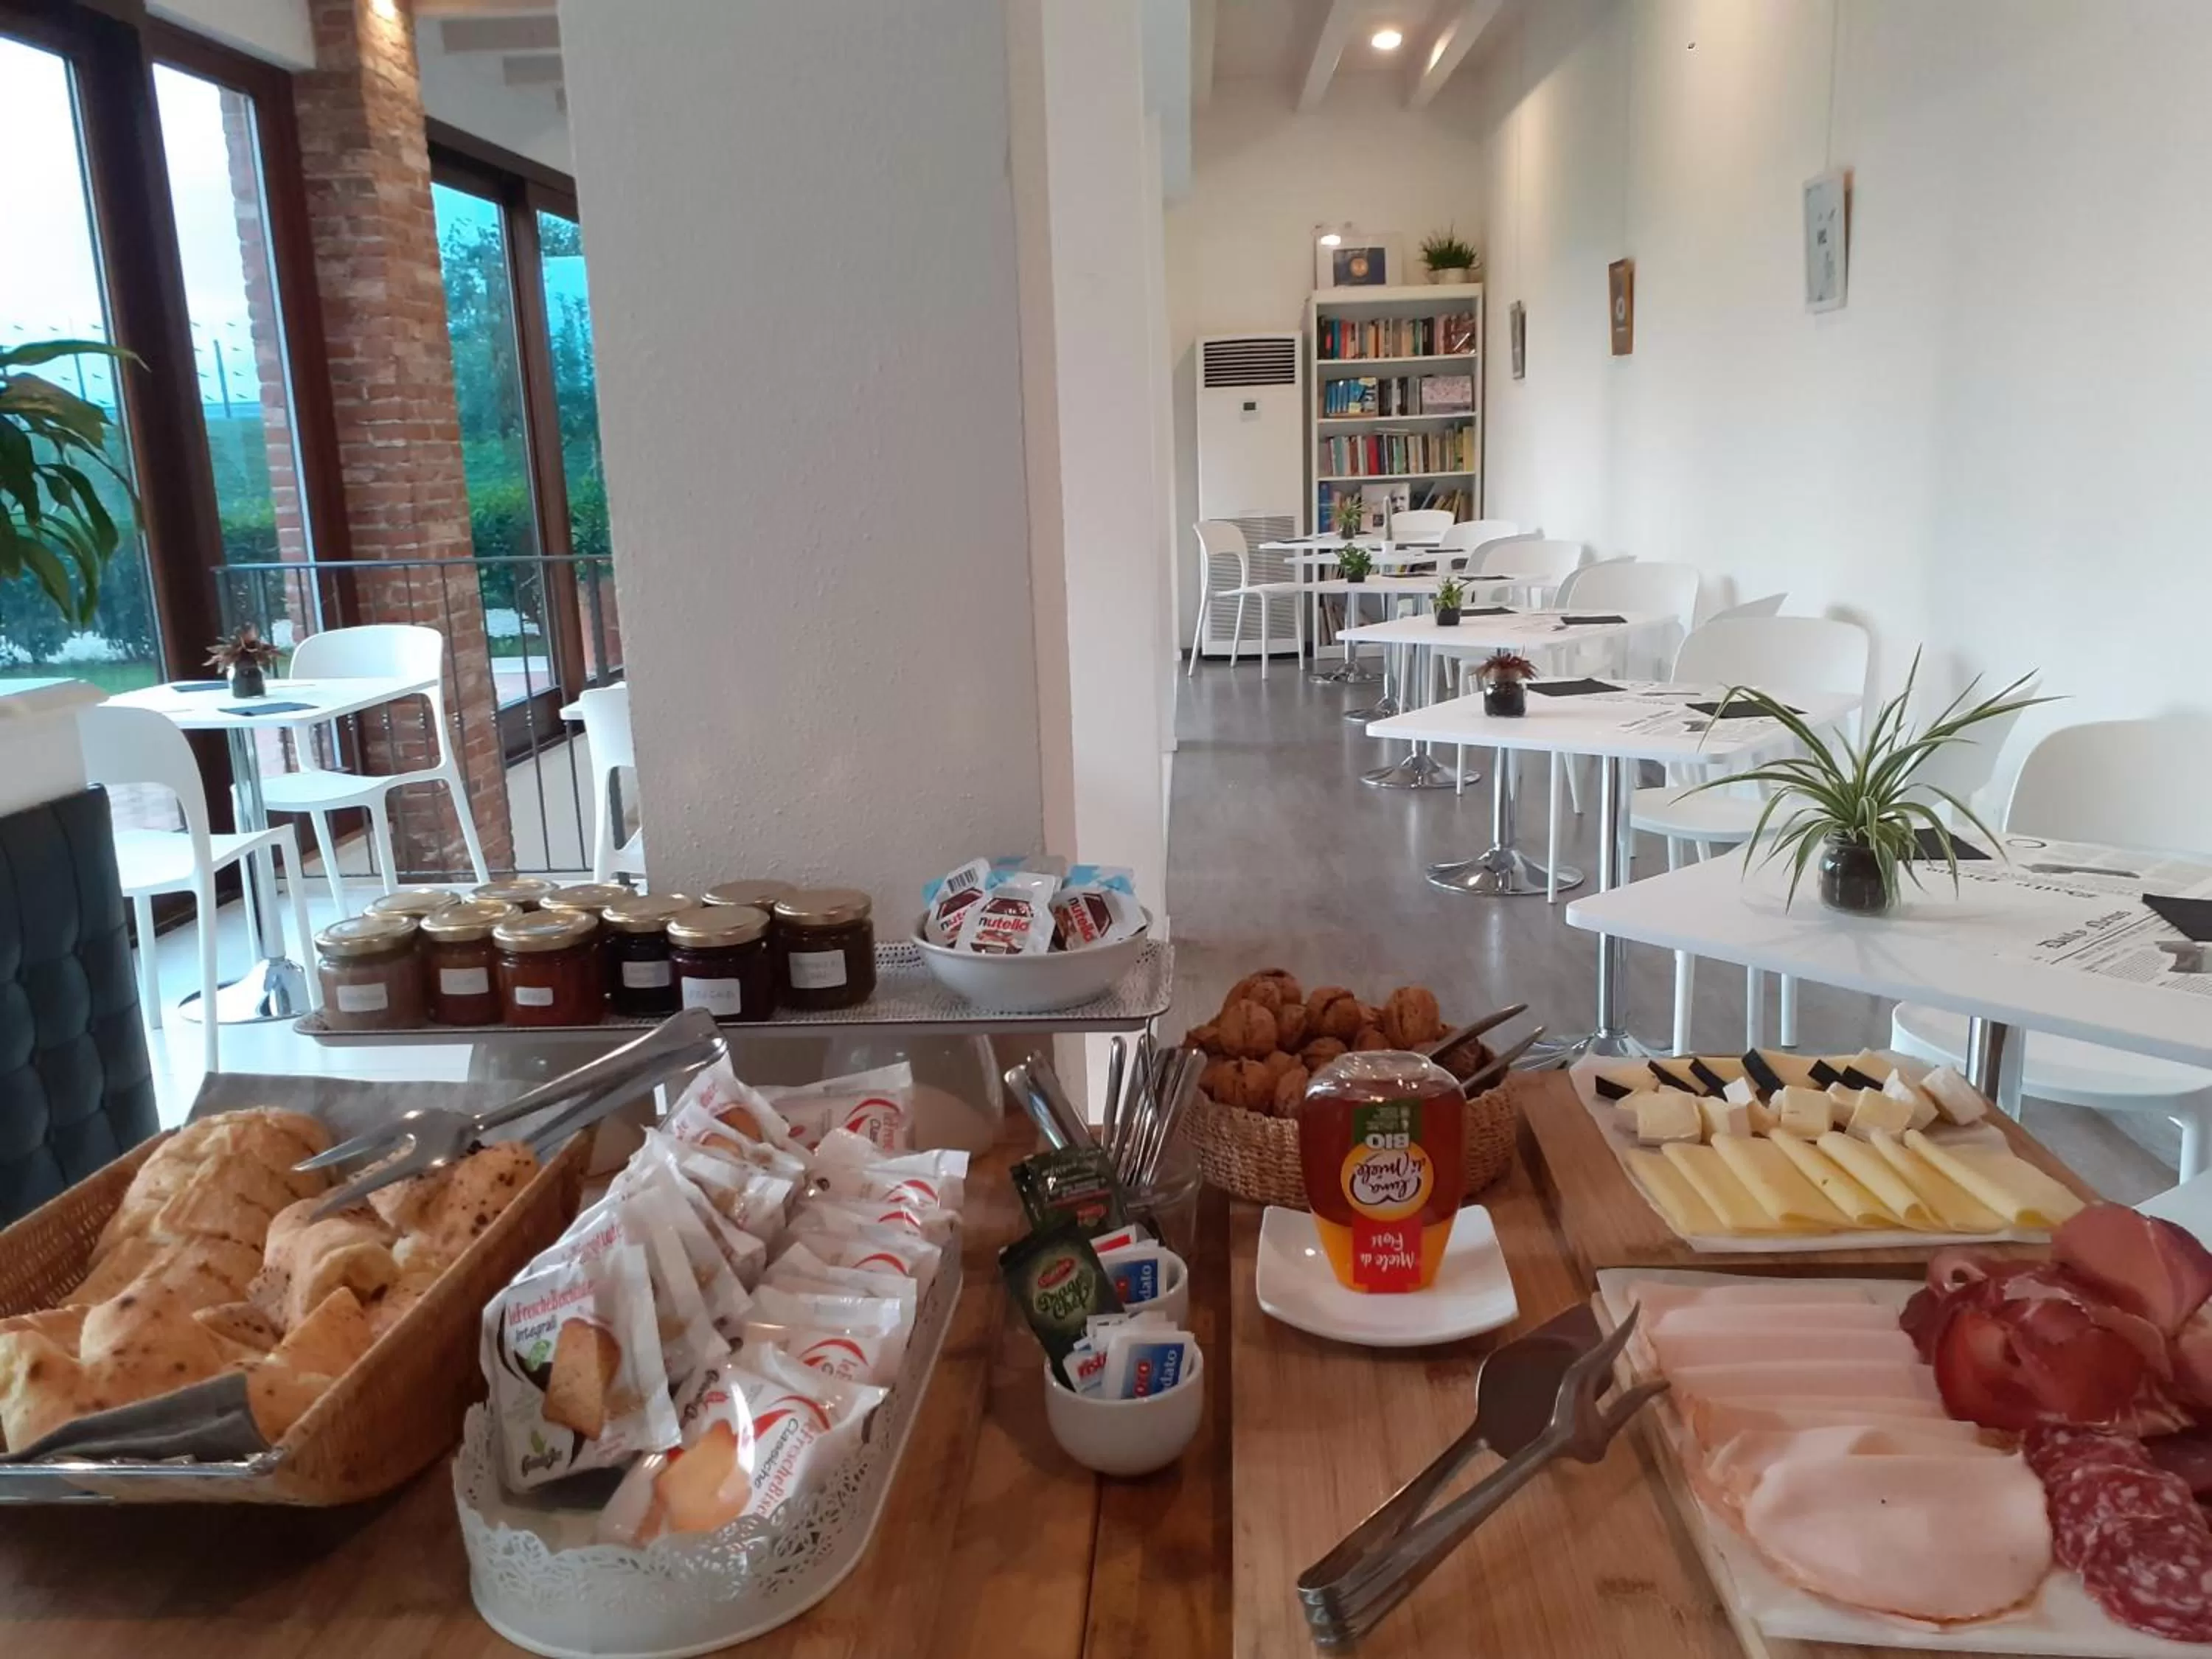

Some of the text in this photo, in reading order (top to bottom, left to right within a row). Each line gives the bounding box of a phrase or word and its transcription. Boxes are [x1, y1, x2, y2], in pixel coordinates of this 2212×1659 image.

[978, 917, 1030, 933] nutella
[1068, 897, 1096, 943] nutella
[1364, 1132, 1410, 1150] BIO
[1376, 1251, 1416, 1273] Miele
[755, 1417, 799, 1489] Classiche
